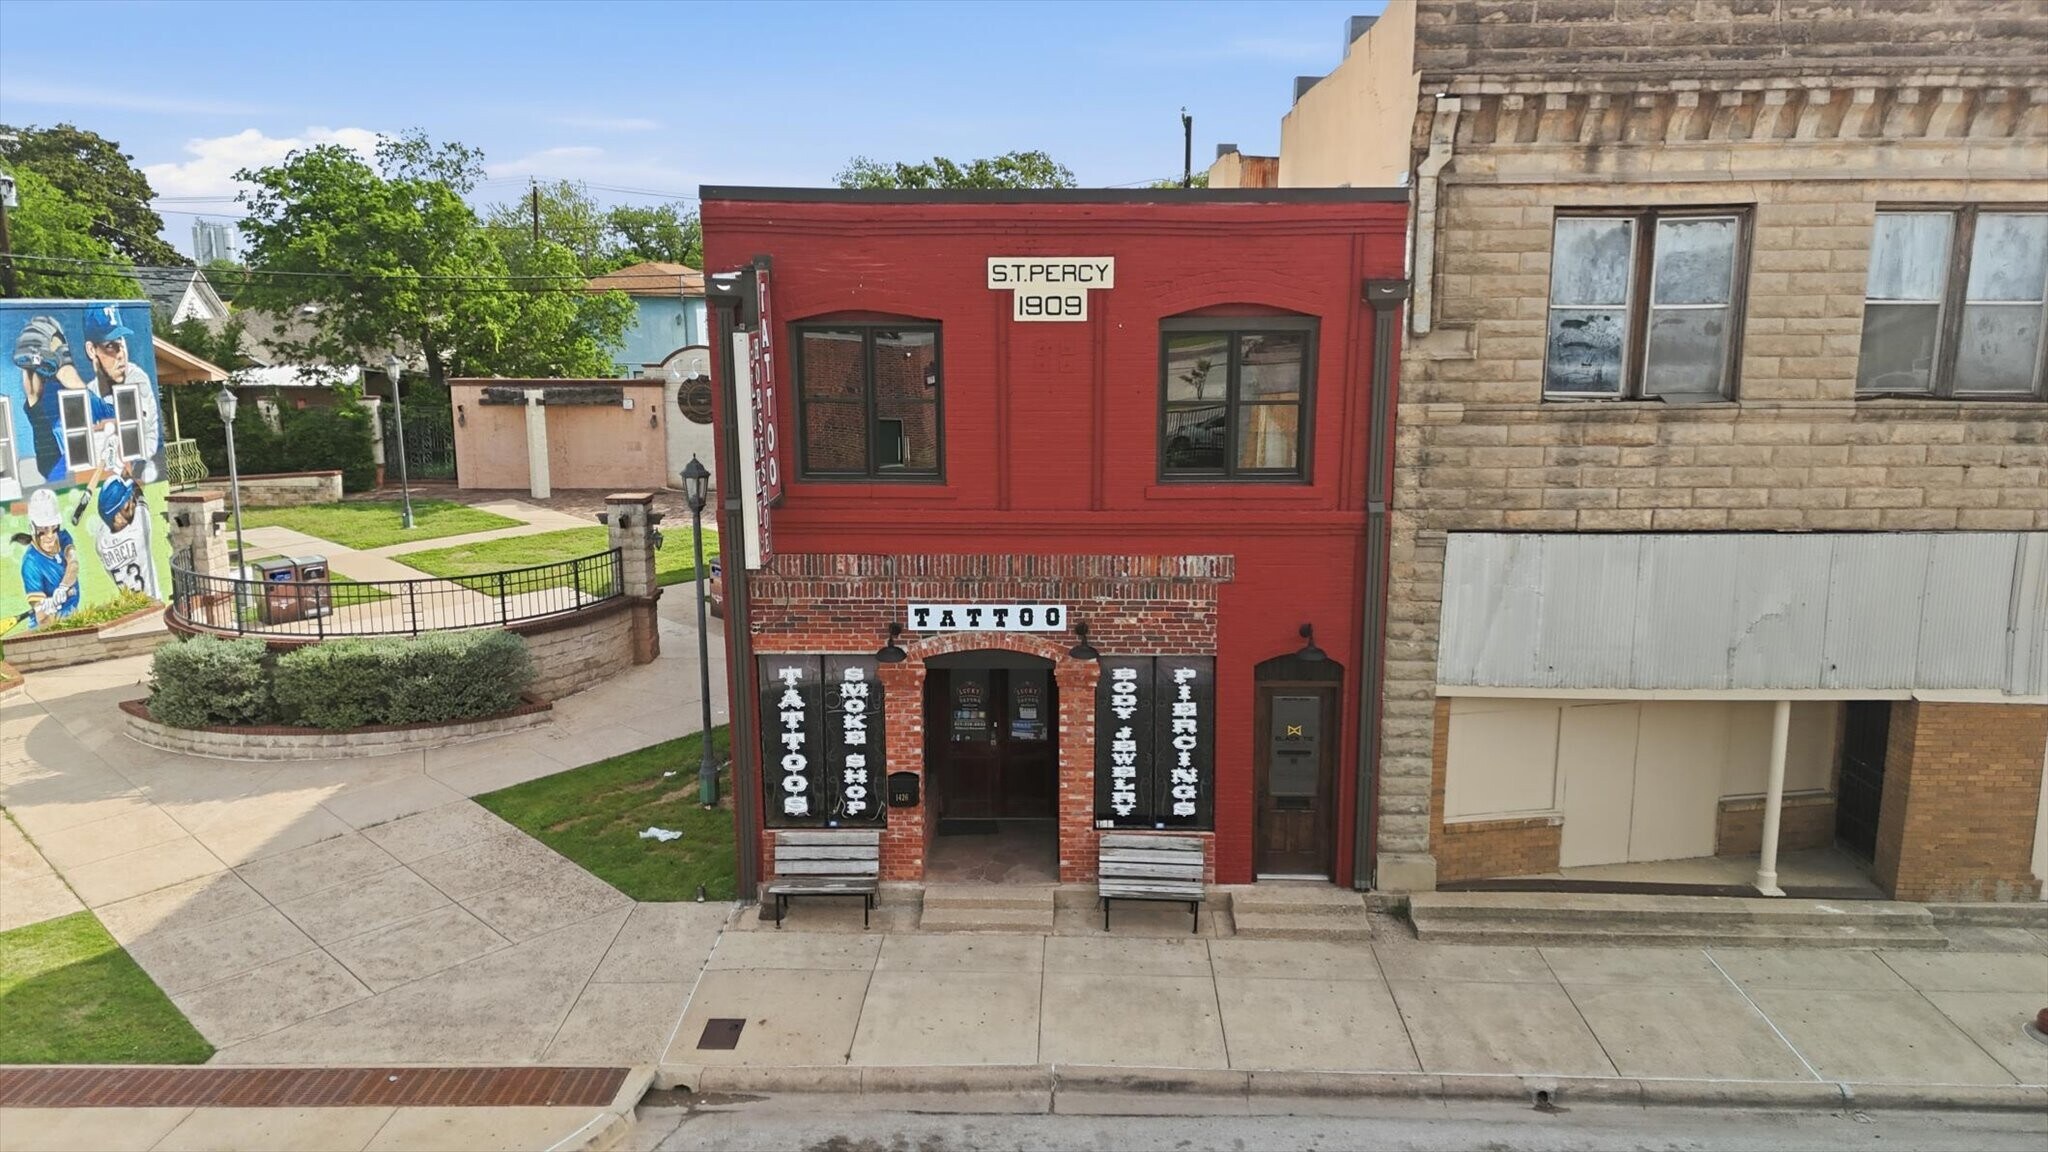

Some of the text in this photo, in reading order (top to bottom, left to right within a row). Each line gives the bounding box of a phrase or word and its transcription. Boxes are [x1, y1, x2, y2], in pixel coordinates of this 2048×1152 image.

[1019, 296, 1081, 315] 1909
[760, 282, 777, 486] TATTOO
[103, 542, 137, 567] GARCIA
[914, 608, 1060, 627] TATTOO
[777, 666, 808, 815] TATTOOS
[840, 666, 869, 815] SMOKE SHOP
[1111, 667, 1137, 817] BODY JEWELRY
[1171, 667, 1198, 817] PIERCINGS
